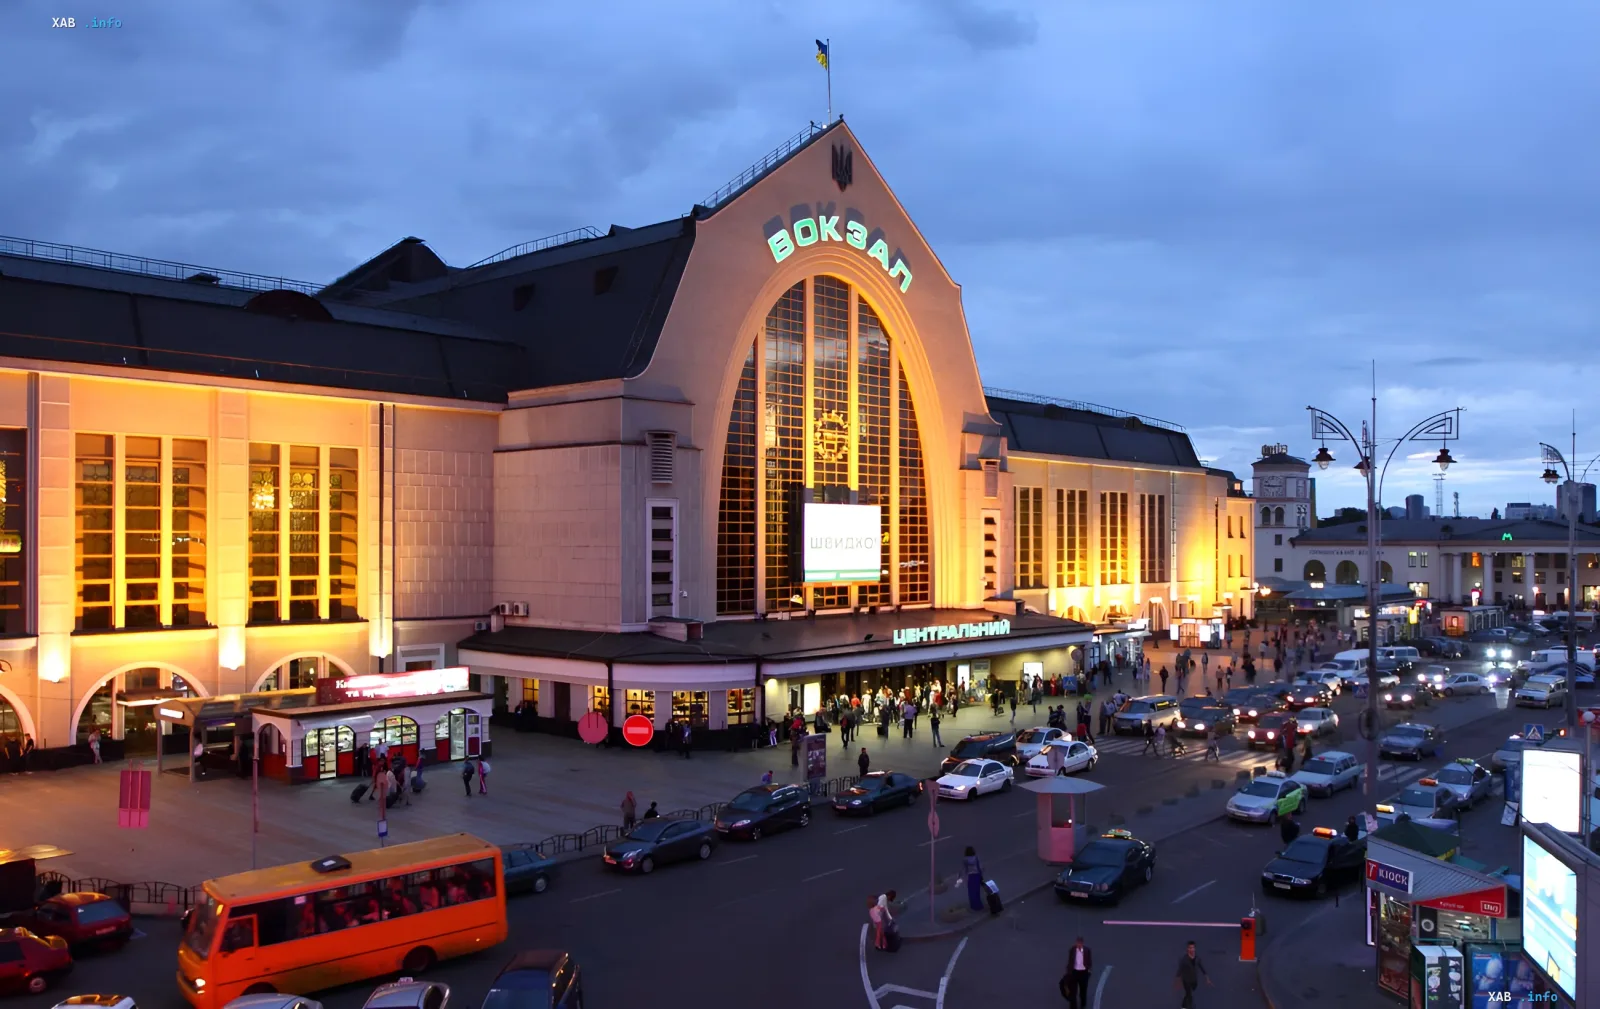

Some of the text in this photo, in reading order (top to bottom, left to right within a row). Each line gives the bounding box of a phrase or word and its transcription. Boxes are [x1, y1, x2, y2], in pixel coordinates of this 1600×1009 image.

[767, 215, 913, 294] ВОКЗАЛ
[893, 619, 1011, 646] ЦЕНТРАЛЬНИЙ
[1378, 868, 1408, 886] КІОСК
